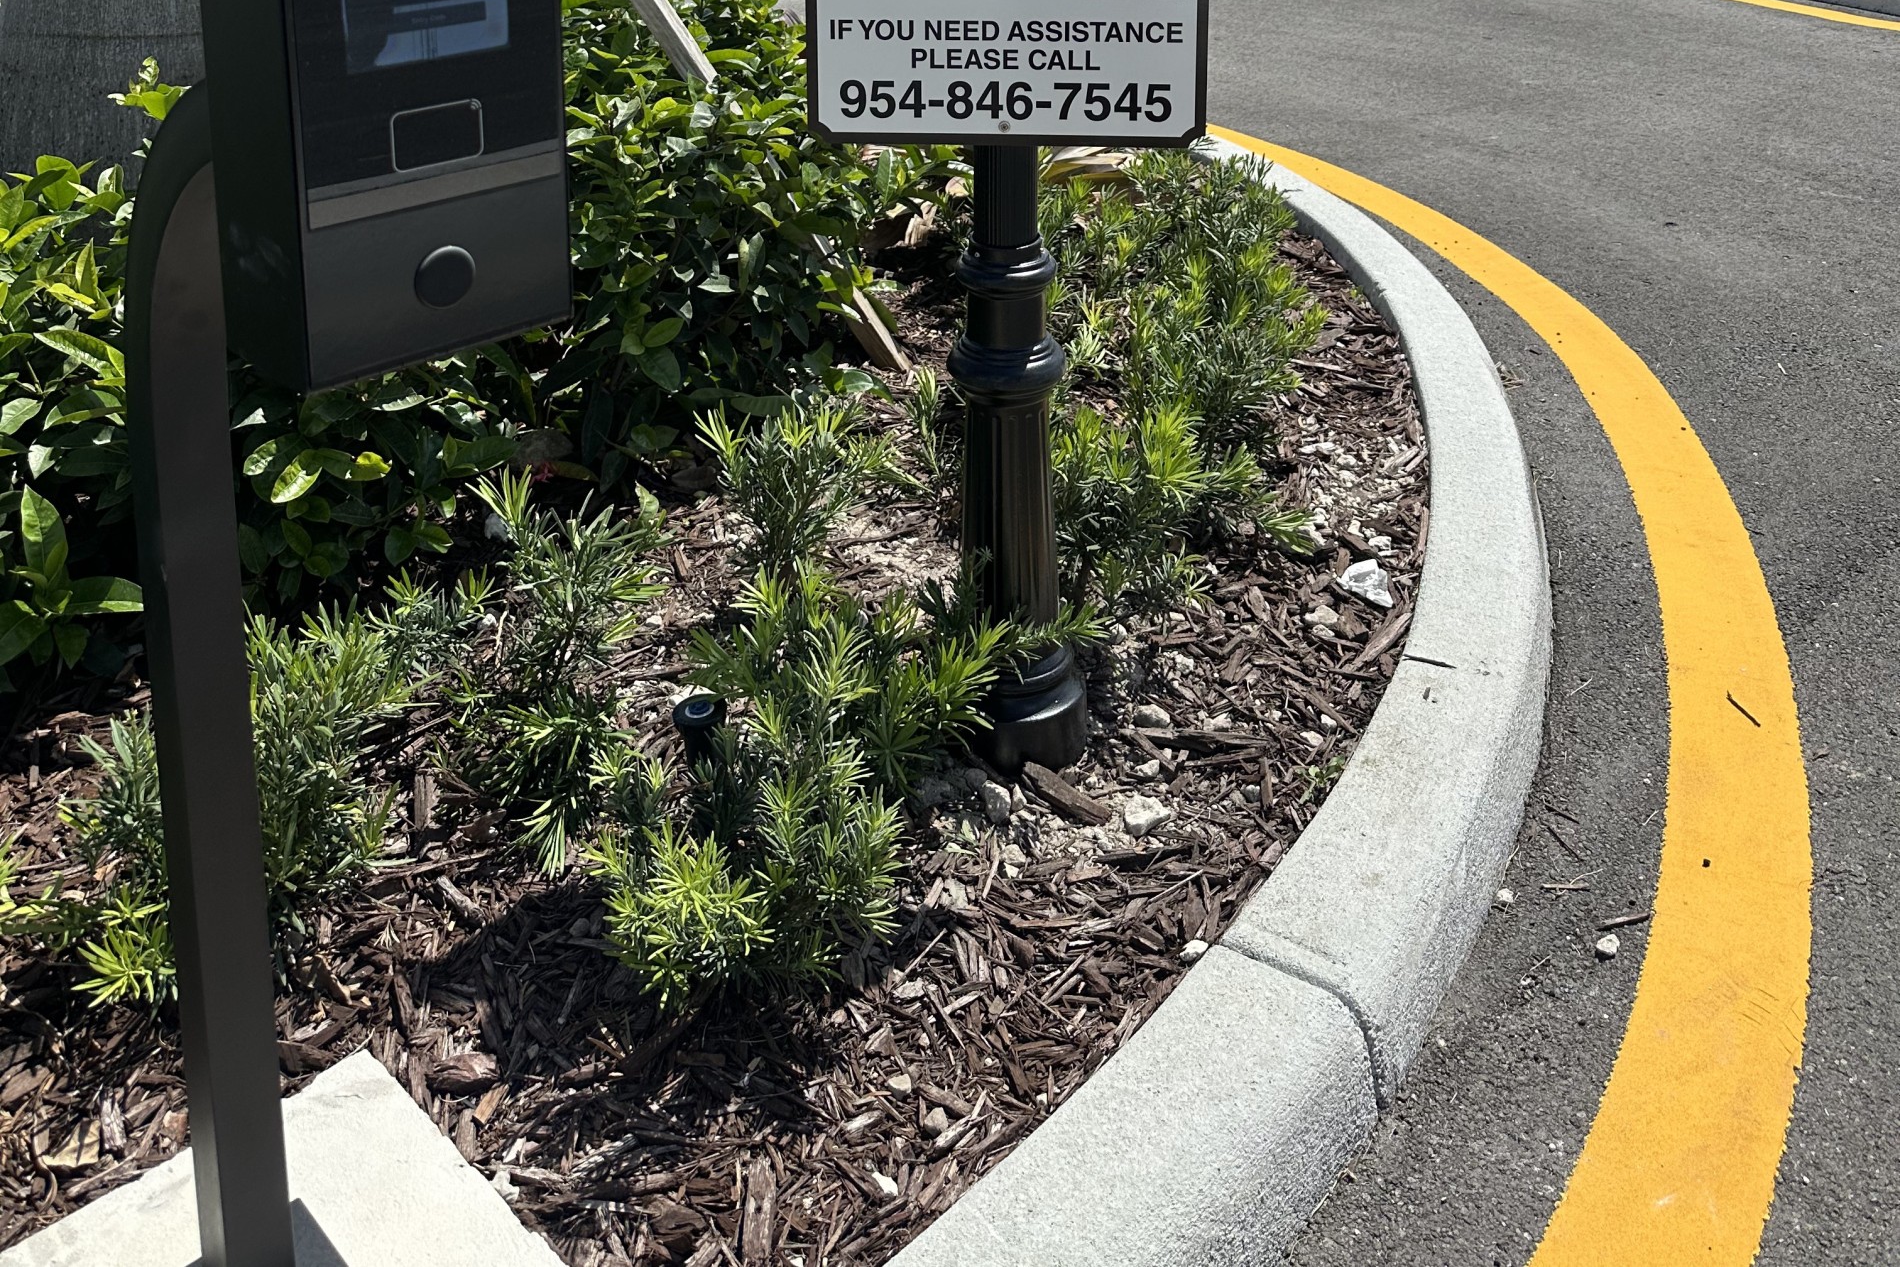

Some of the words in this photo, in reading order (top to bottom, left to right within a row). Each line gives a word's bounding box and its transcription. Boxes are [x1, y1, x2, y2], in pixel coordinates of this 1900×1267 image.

[829, 19, 853, 40] IF
[858, 19, 914, 40] YOU
[924, 20, 1000, 41] NEED
[1007, 20, 1183, 43] ASSISTANCE
[911, 48, 1019, 70] PLEASE
[1028, 49, 1100, 71] CALL
[839, 79, 1172, 122] 954-846-7545
